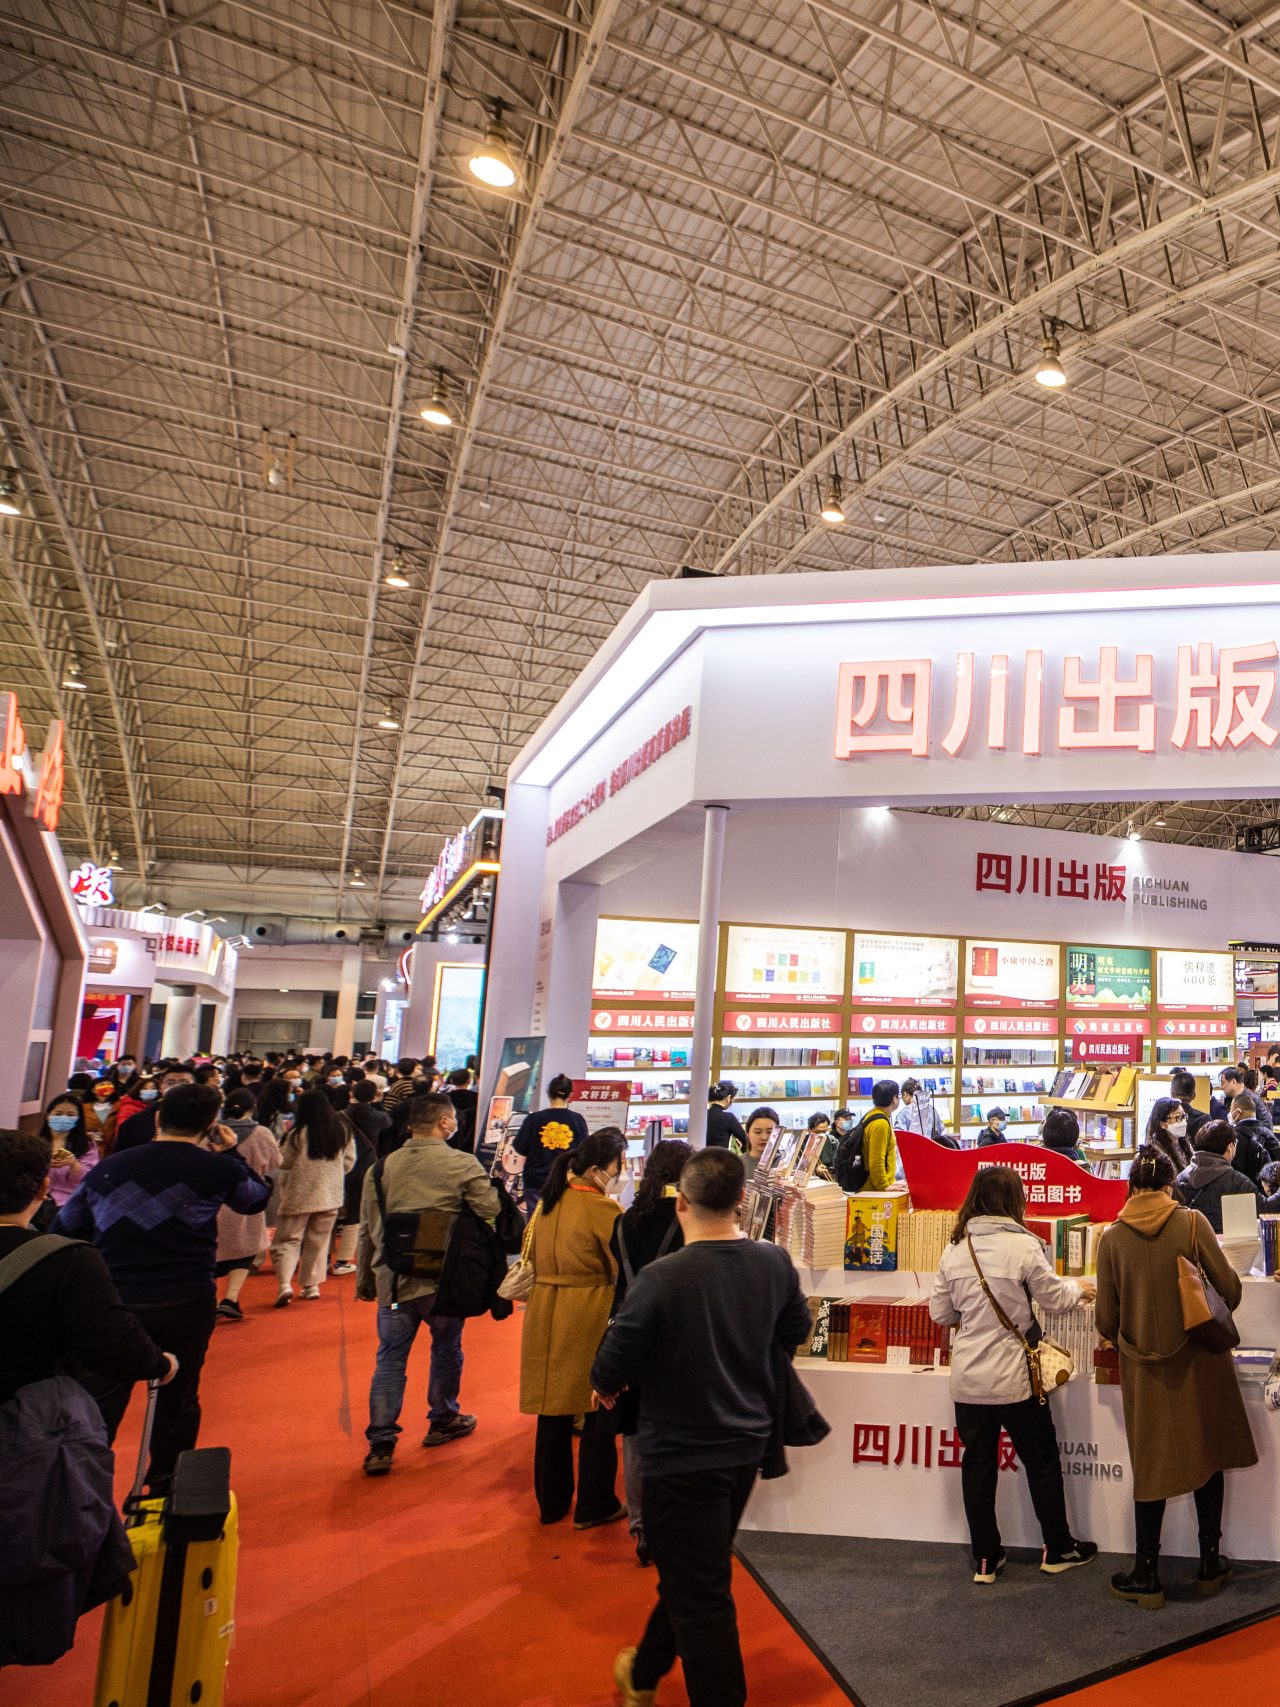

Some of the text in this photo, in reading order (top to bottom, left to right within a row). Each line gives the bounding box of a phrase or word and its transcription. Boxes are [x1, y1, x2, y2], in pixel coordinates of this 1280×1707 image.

[833, 641, 1280, 760] 四川出版
[976, 852, 1127, 902] 四川出版
[1132, 876, 1190, 893] SICHUAN
[1132, 892, 1208, 911] PUBLISHING
[1001, 956, 1054, 967] 小康中国之路
[756, 1017, 831, 1029] 四川人民出版社
[880, 1019, 946, 1031] 四川人民出版社
[990, 1020, 1050, 1032] 四川人民出版社
[1089, 1043, 1130, 1055] 四川民族出版社
[579, 1090, 620, 1100] 文轩好书
[869, 1210, 884, 1265] 中国童话
